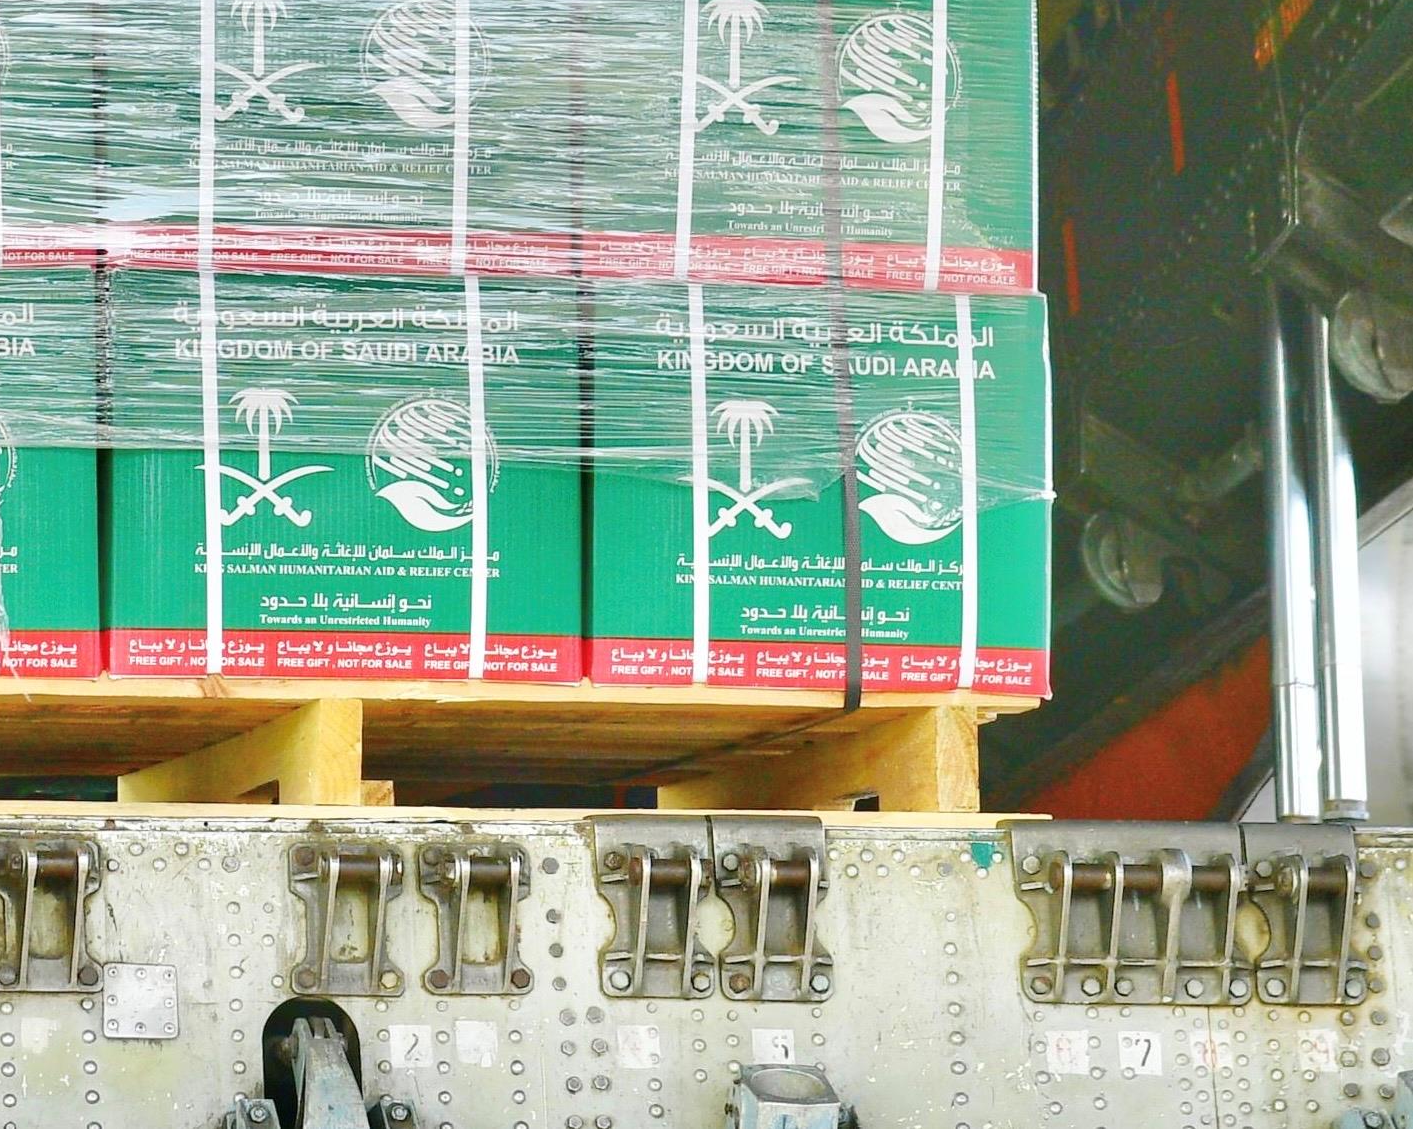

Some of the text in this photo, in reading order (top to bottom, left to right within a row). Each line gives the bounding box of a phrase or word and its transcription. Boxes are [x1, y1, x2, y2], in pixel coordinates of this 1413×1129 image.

[175, 338, 292, 360] KIGDOM
[301, 341, 334, 360] OF
[342, 341, 416, 363] SAUDI
[781, 352, 813, 374] OF
[903, 357, 996, 380] ARAIA
[227, 563, 451, 577] SALMAN HUMANITARIAN AID & RELIEF
[708, 575, 757, 586] SALMAN
[876, 579, 886, 589] &
[888, 579, 929, 590] RELIEF
[931, 580, 963, 591] CENT
[260, 614, 432, 629] Towards an Unrestricted Humanity
[740, 624, 782, 635] Towards
[784, 628, 796, 636] an
[861, 627, 910, 641] Humanity
[2, 657, 25, 668] NOT
[26, 657, 49, 668] FOR
[50, 658, 78, 668] SALE
[129, 656, 157, 666] FREE
[235, 657, 265, 667] SALE
[277, 657, 305, 668] FREE
[338, 658, 360, 668] NOT
[361, 659, 384, 669] FOR
[385, 659, 412, 670] SALE
[424, 660, 452, 670] FREE
[484, 661, 506, 671] NOT
[507, 661, 530, 672] FOR
[531, 662, 557, 673] SALE
[611, 665, 638, 675] FREE
[671, 666, 693, 676] NOT
[718, 667, 744, 677] SALE
[756, 668, 783, 678] FREE
[815, 670, 837, 679] NOT
[862, 671, 889, 680] SALE
[901, 672, 928, 681] FREE
[982, 674, 1003, 684] FOR
[1004, 675, 1031, 686] SALE
[1135, 1038, 1152, 1067] 7
